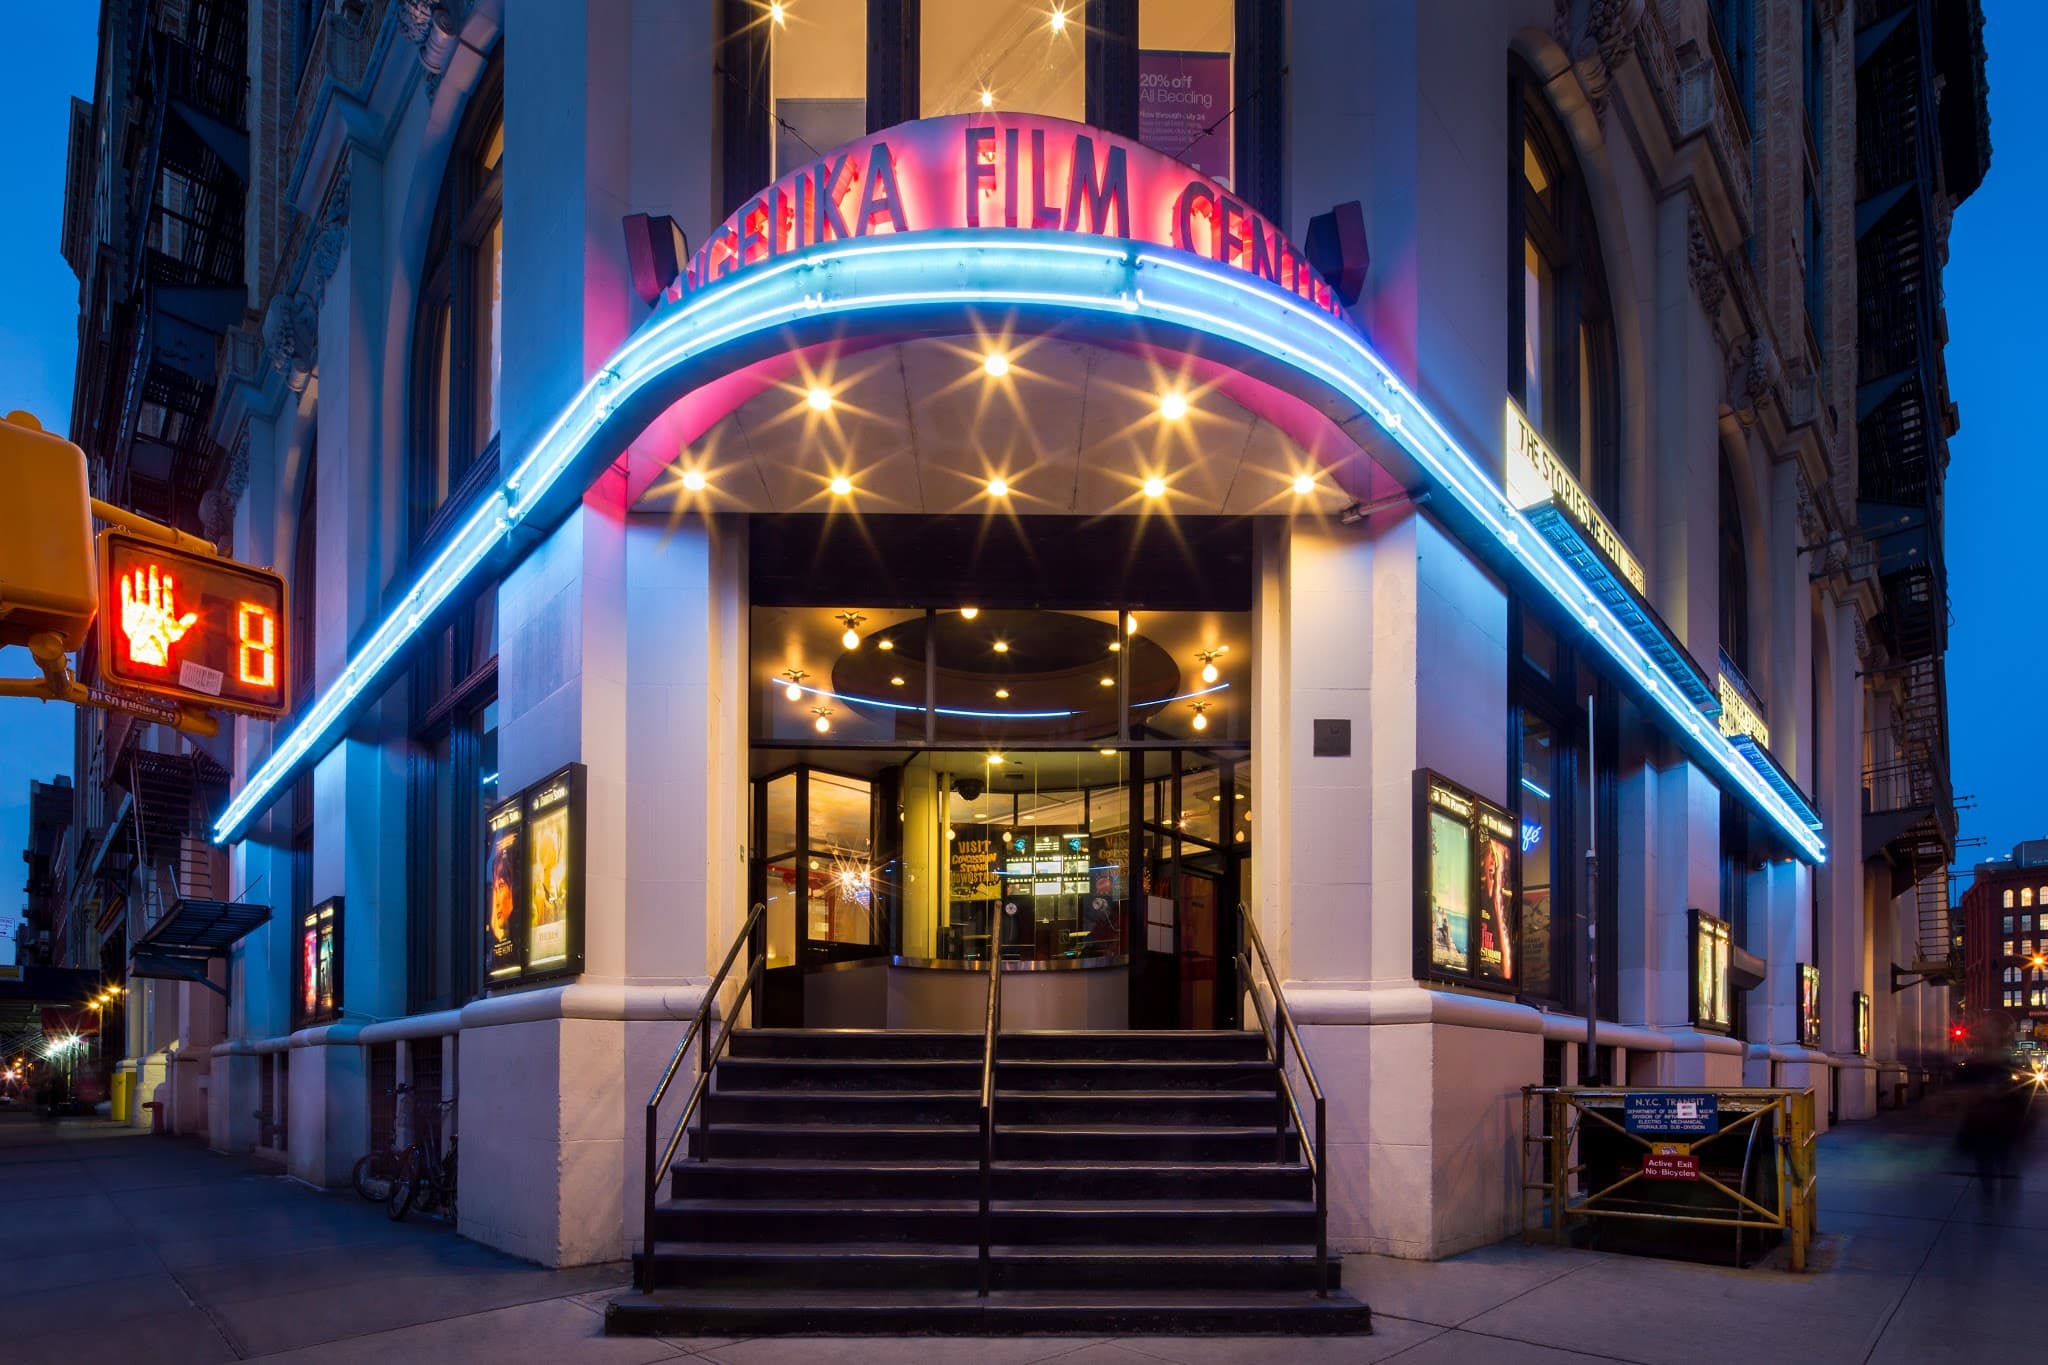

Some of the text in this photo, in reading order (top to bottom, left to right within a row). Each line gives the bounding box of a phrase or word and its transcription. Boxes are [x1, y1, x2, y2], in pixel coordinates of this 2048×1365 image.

[1139, 73, 1193, 88] 20% off
[1139, 88, 1213, 108] All Bedding
[657, 127, 1345, 320] GELIKA FILM CENT
[1518, 418, 1539, 470] THE
[1542, 450, 1590, 529] STORIES
[238, 600, 275, 687] 8
[88, 690, 119, 707] ALSO
[958, 840, 992, 853] VISIT
[1635, 1098, 1705, 1106] N.Y.C. TRANSIT
[1648, 1159, 1673, 1167] Active
[1645, 1167, 1696, 1178] No Bicycles
